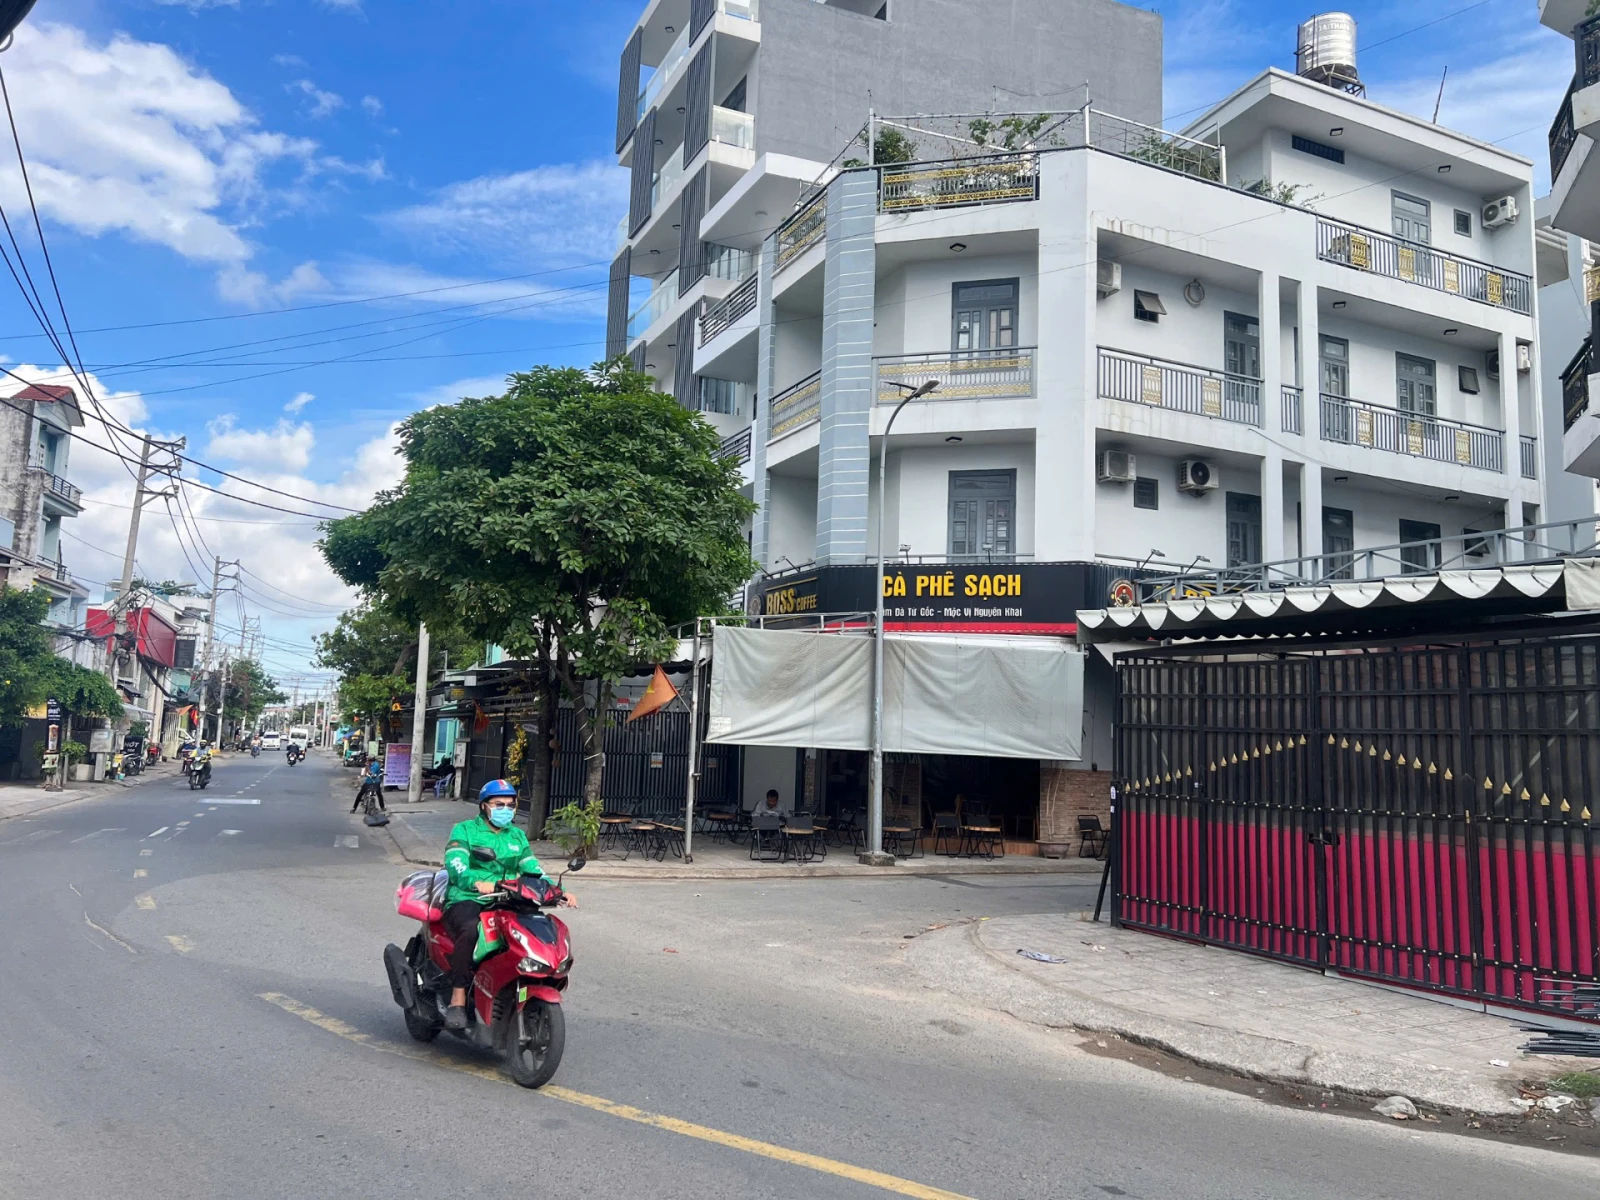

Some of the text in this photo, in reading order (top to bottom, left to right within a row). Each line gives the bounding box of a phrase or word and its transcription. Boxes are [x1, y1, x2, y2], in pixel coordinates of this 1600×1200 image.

[882, 571, 1021, 601] CÀ PHÊ SẠCH
[766, 588, 817, 615] BOSS COFFEE
